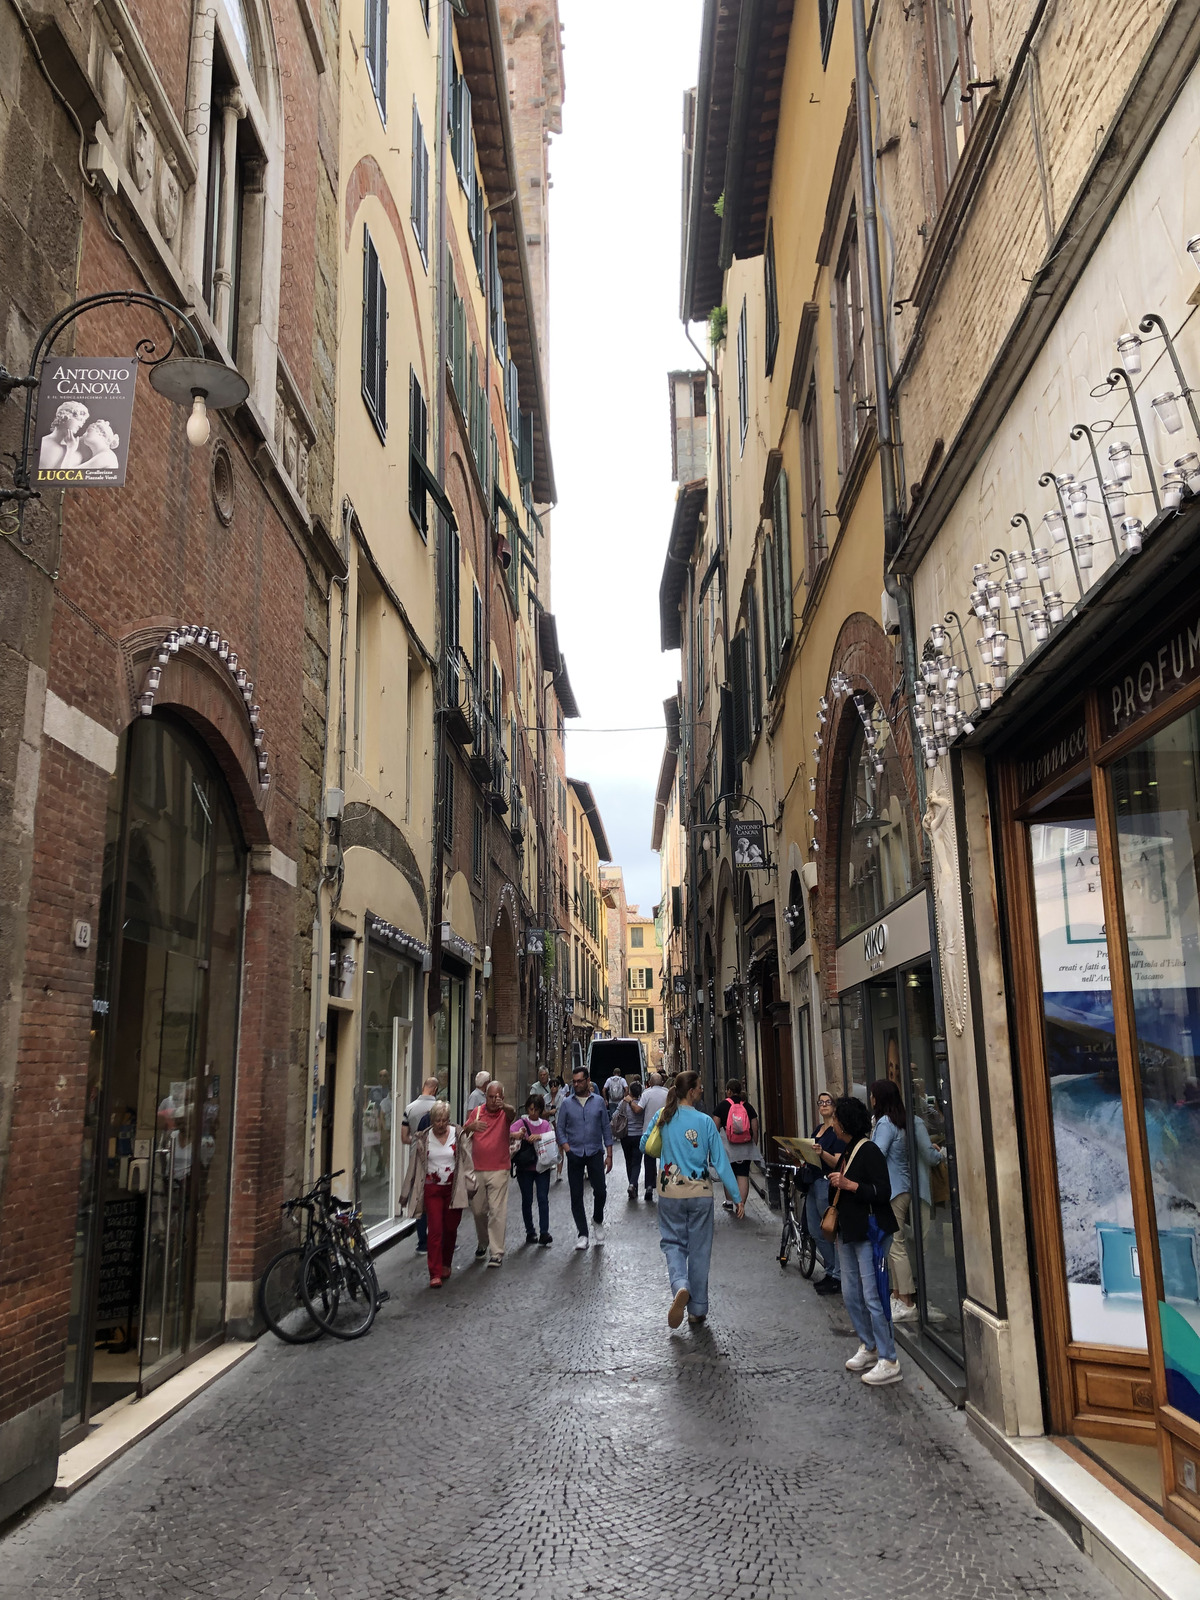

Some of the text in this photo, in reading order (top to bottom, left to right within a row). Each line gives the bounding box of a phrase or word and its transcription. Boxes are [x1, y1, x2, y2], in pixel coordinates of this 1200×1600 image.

[52, 366, 130, 381] ANTONIO
[57, 380, 121, 394] CANOVA
[37, 470, 84, 481] LUCCA
[78, 925, 88, 944] 42
[863, 923, 886, 961] KIKO
[1058, 963, 1078, 971] creati
[1083, 962, 1099, 973] fatti
[1135, 972, 1164, 981] Toscano
